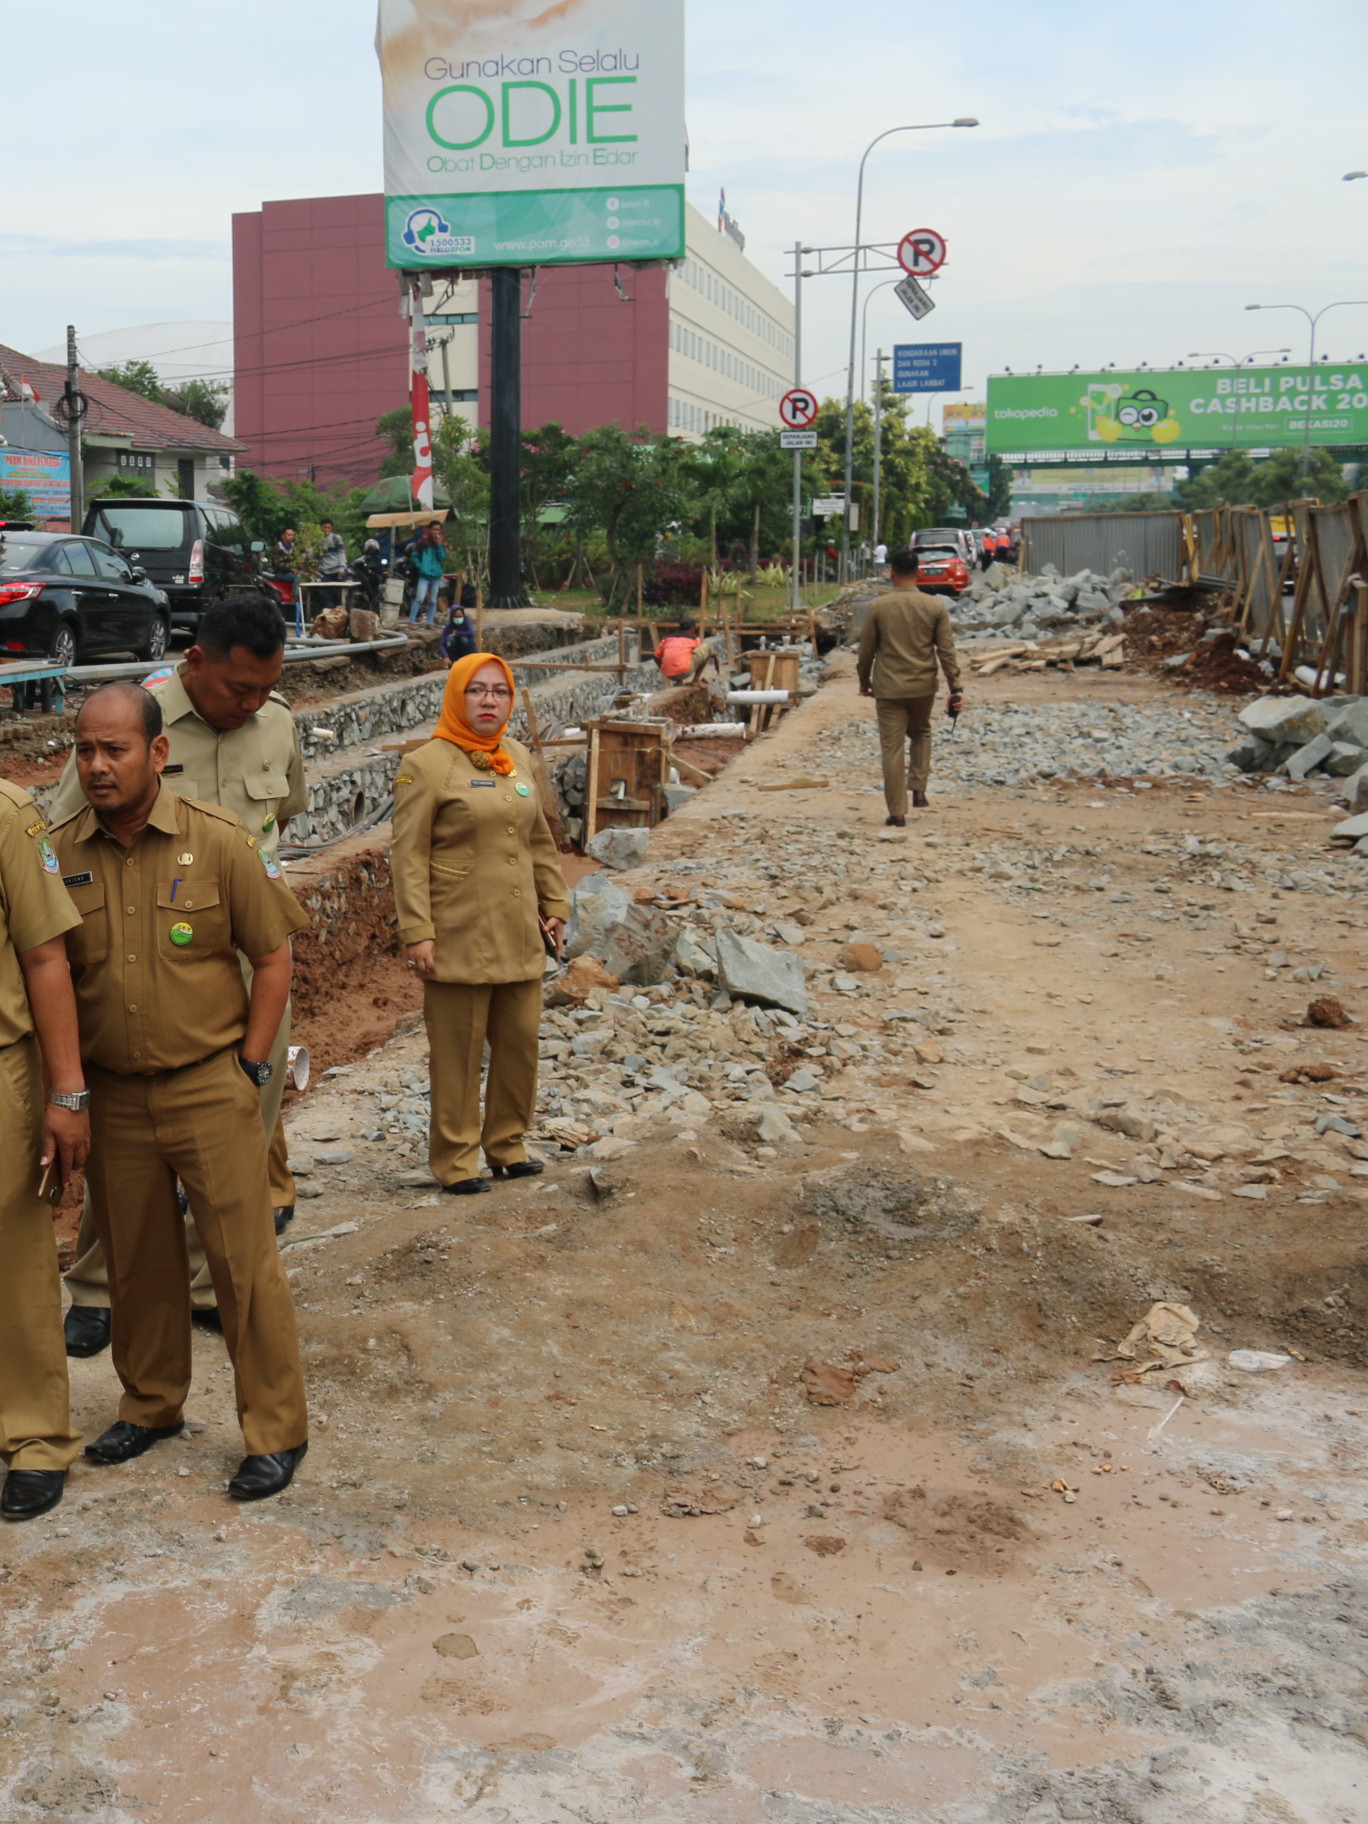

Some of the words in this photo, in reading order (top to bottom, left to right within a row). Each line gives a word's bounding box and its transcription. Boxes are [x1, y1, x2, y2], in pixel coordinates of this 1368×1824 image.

[424, 53, 552, 81] Gunakan
[558, 48, 640, 75] Selalu
[425, 75, 639, 151] ODIE
[427, 154, 475, 173] Obat
[479, 151, 557, 173] Dengan
[559, 148, 589, 168] Izin
[592, 148, 639, 166] Edar
[430, 238, 472, 247] 1500533
[494, 235, 590, 252] www.pom.go.id
[1216, 377, 1272, 395] BELI
[1279, 373, 1364, 393] PULSA
[994, 405, 1058, 421] tokopedia
[1189, 393, 1328, 415] CASHBACK
